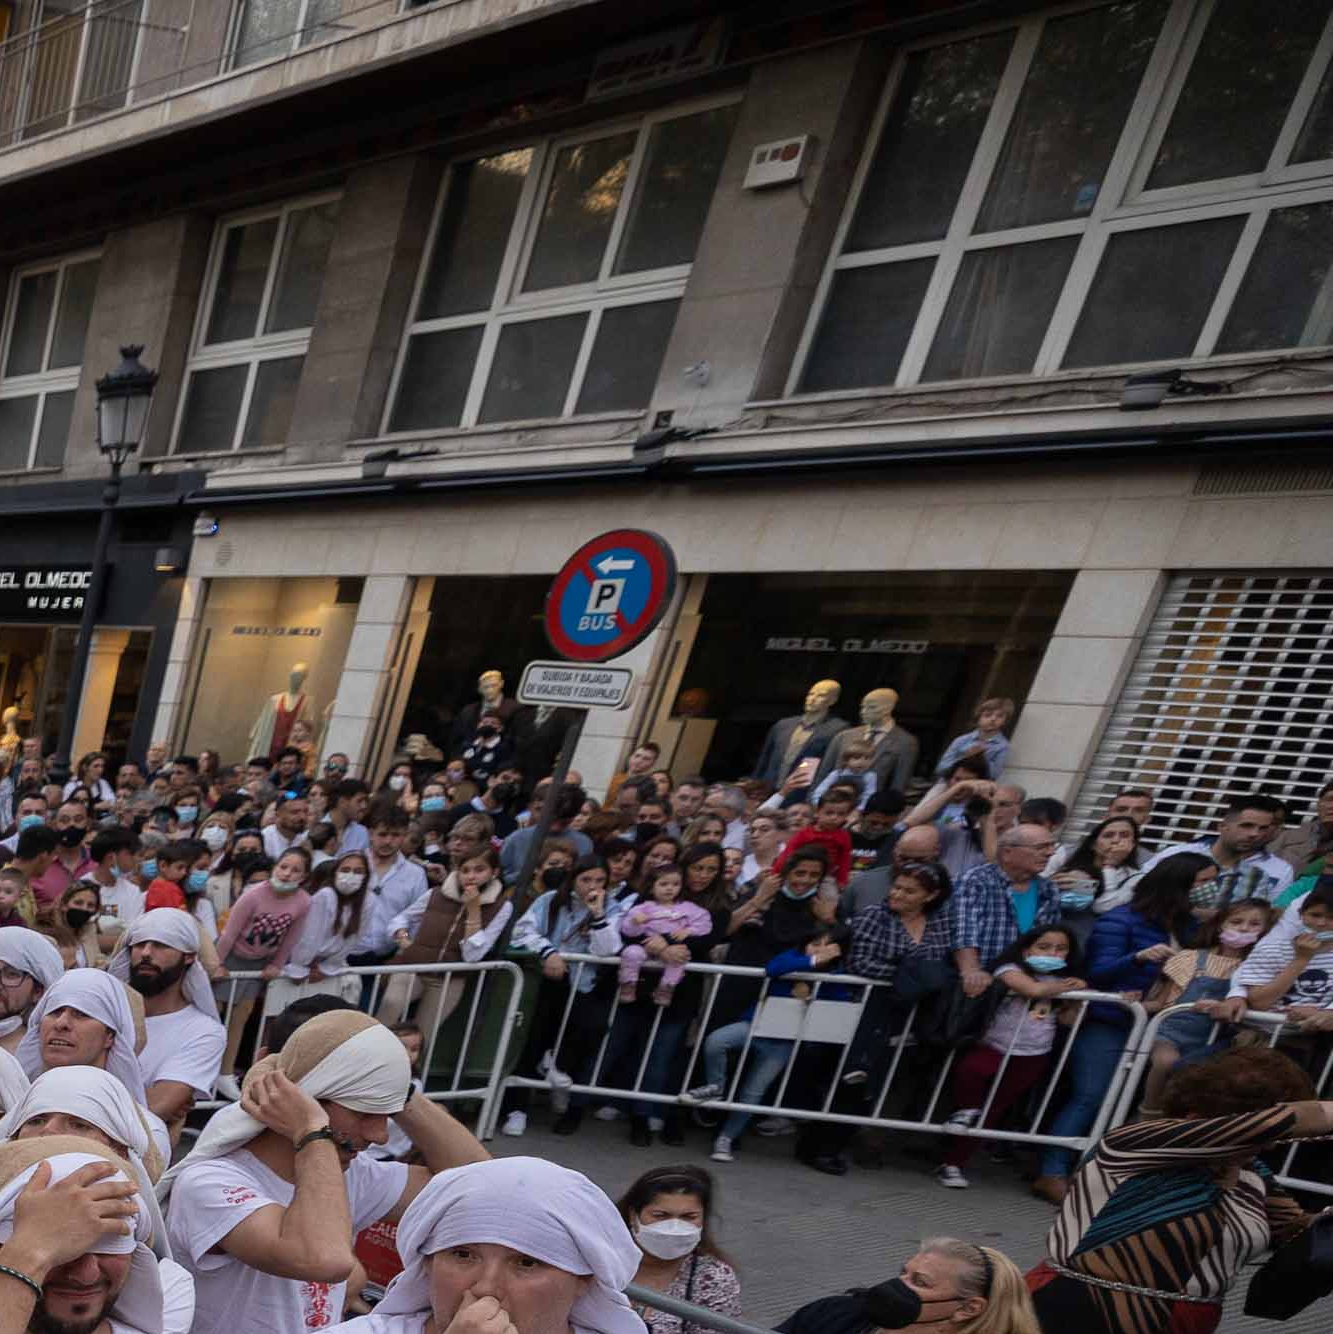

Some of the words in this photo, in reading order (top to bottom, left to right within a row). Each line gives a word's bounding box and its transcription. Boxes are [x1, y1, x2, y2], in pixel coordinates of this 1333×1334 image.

[26, 595, 85, 610] MUJER
[595, 583, 617, 609] P
[576, 614, 618, 632] BUS
[765, 637, 836, 651] MIGUEL
[841, 639, 931, 653] OLMEDO
[542, 671, 573, 682] SUBIDA
[580, 673, 613, 685] BAJADA
